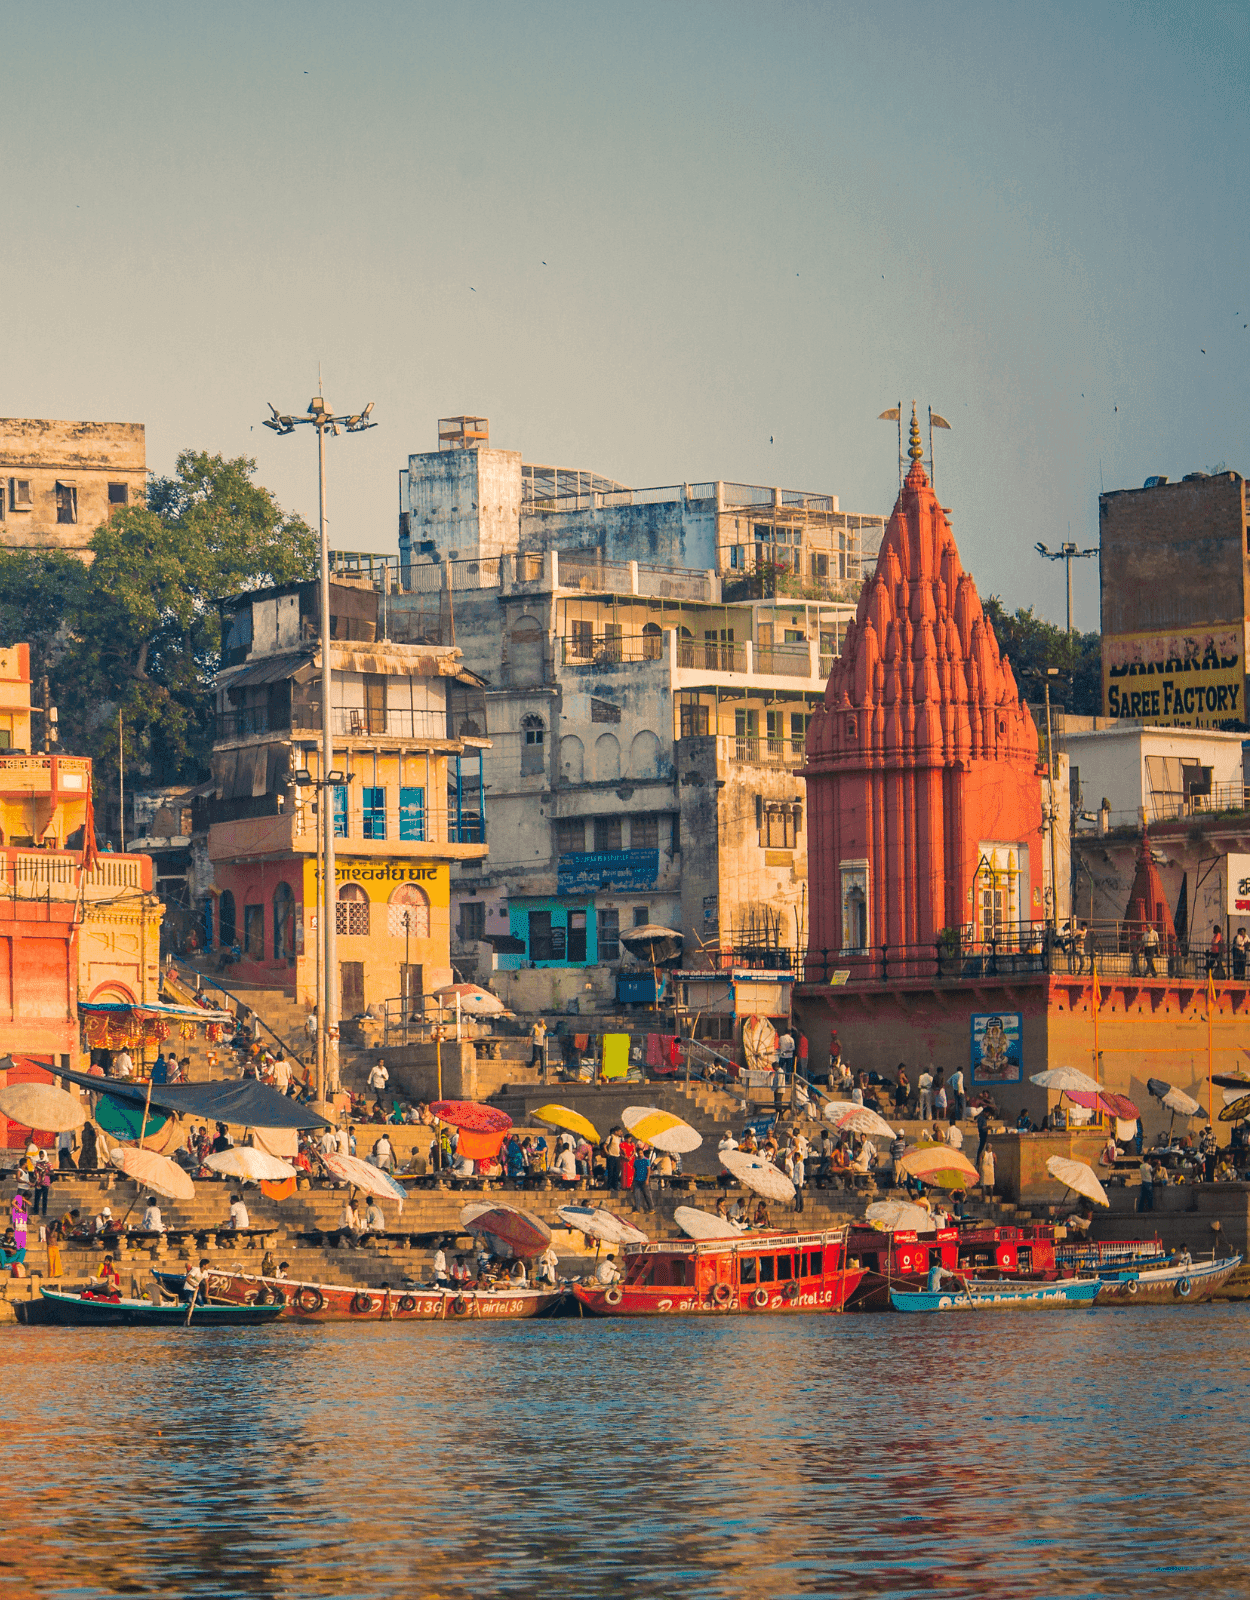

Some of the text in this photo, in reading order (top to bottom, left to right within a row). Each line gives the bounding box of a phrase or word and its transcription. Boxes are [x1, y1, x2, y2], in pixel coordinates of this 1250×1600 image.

[1108, 681, 1240, 718] SAREE FACTORY
[408, 868, 437, 880] घाट
[482, 1300, 524, 1314] airtel 3G
[679, 1298, 715, 1310] airtel
